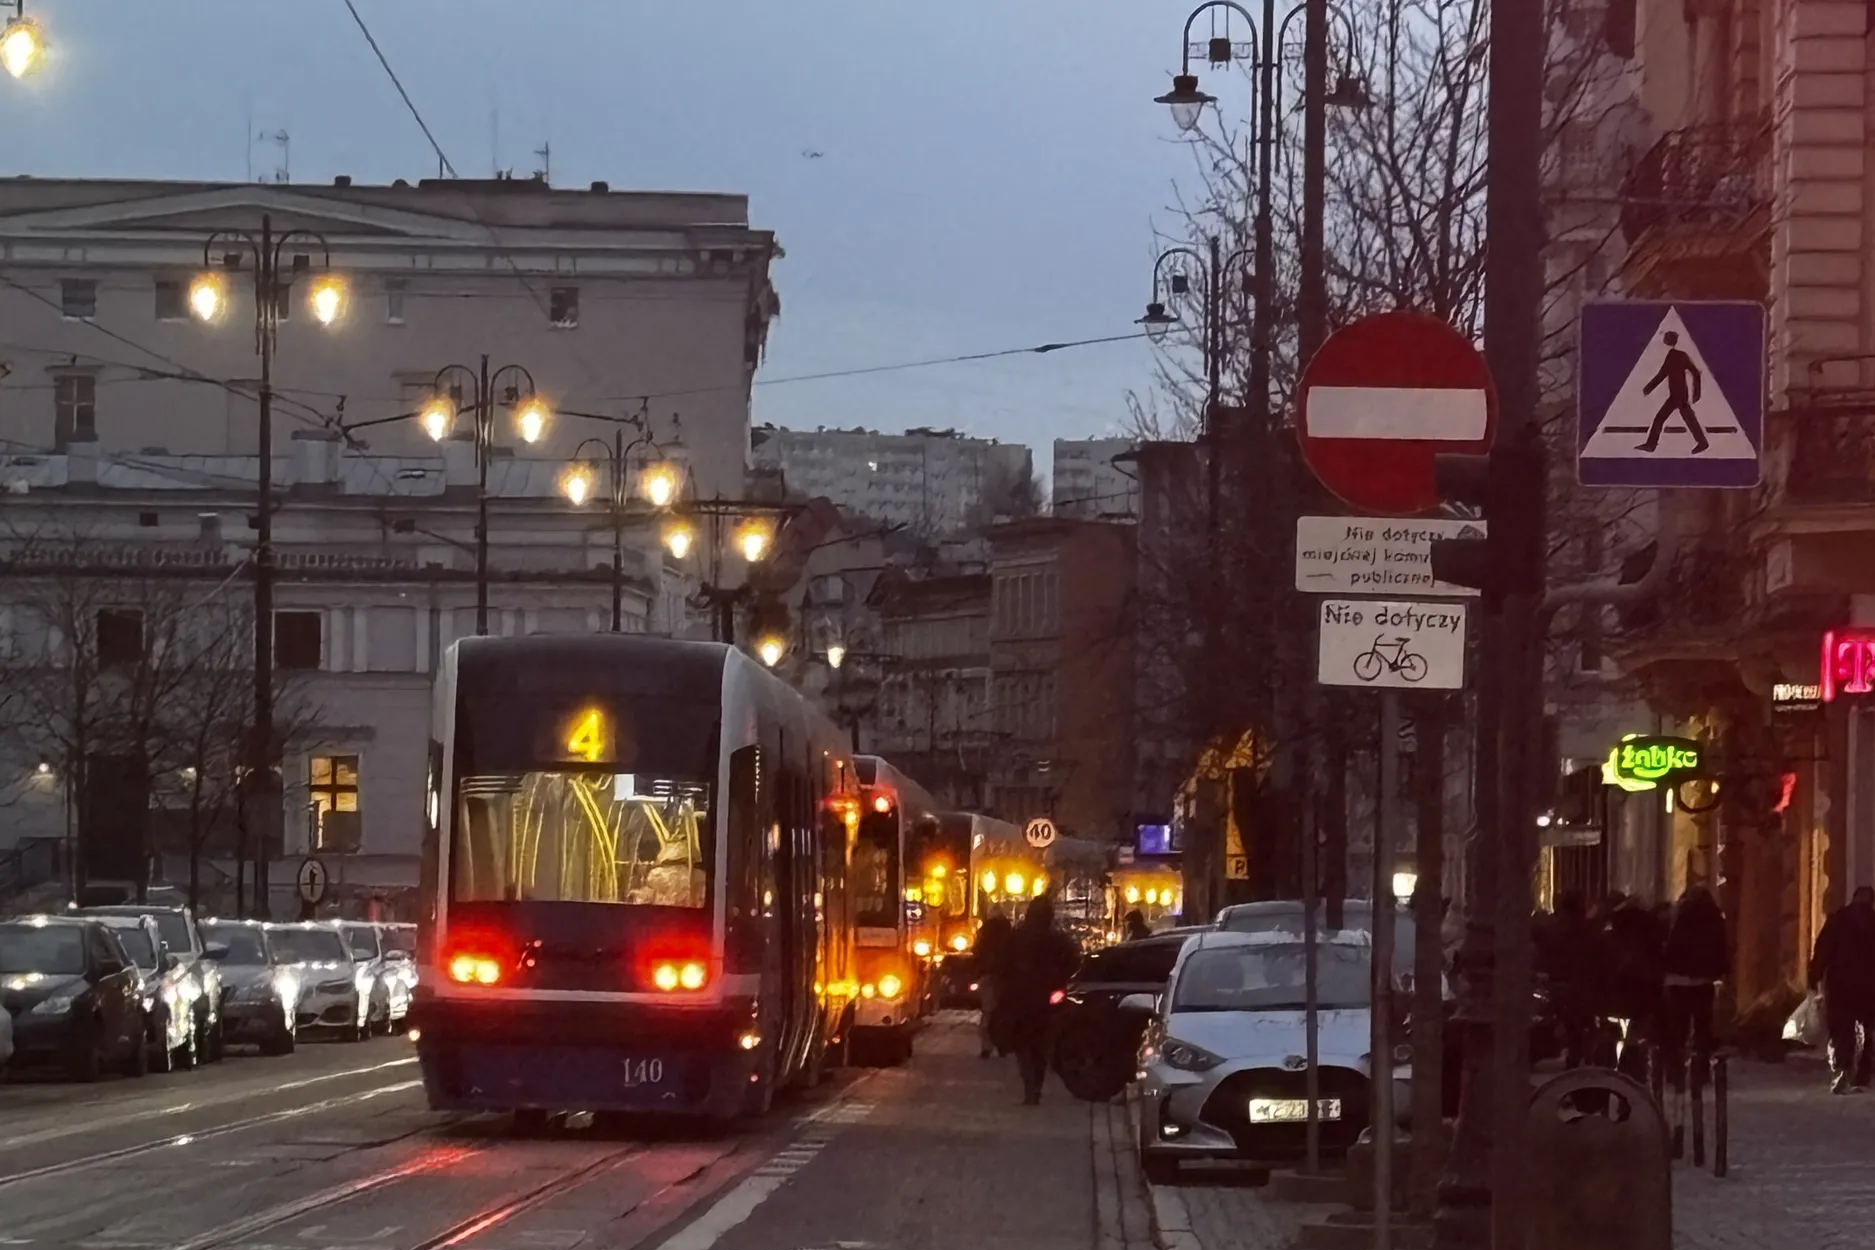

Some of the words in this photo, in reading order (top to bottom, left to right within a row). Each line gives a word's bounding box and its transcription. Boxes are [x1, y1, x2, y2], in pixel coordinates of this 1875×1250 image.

[1324, 604, 1363, 625] Nie
[1375, 605, 1461, 634] dotyczy
[568, 710, 603, 761] 4
[623, 1058, 663, 1084] 140
